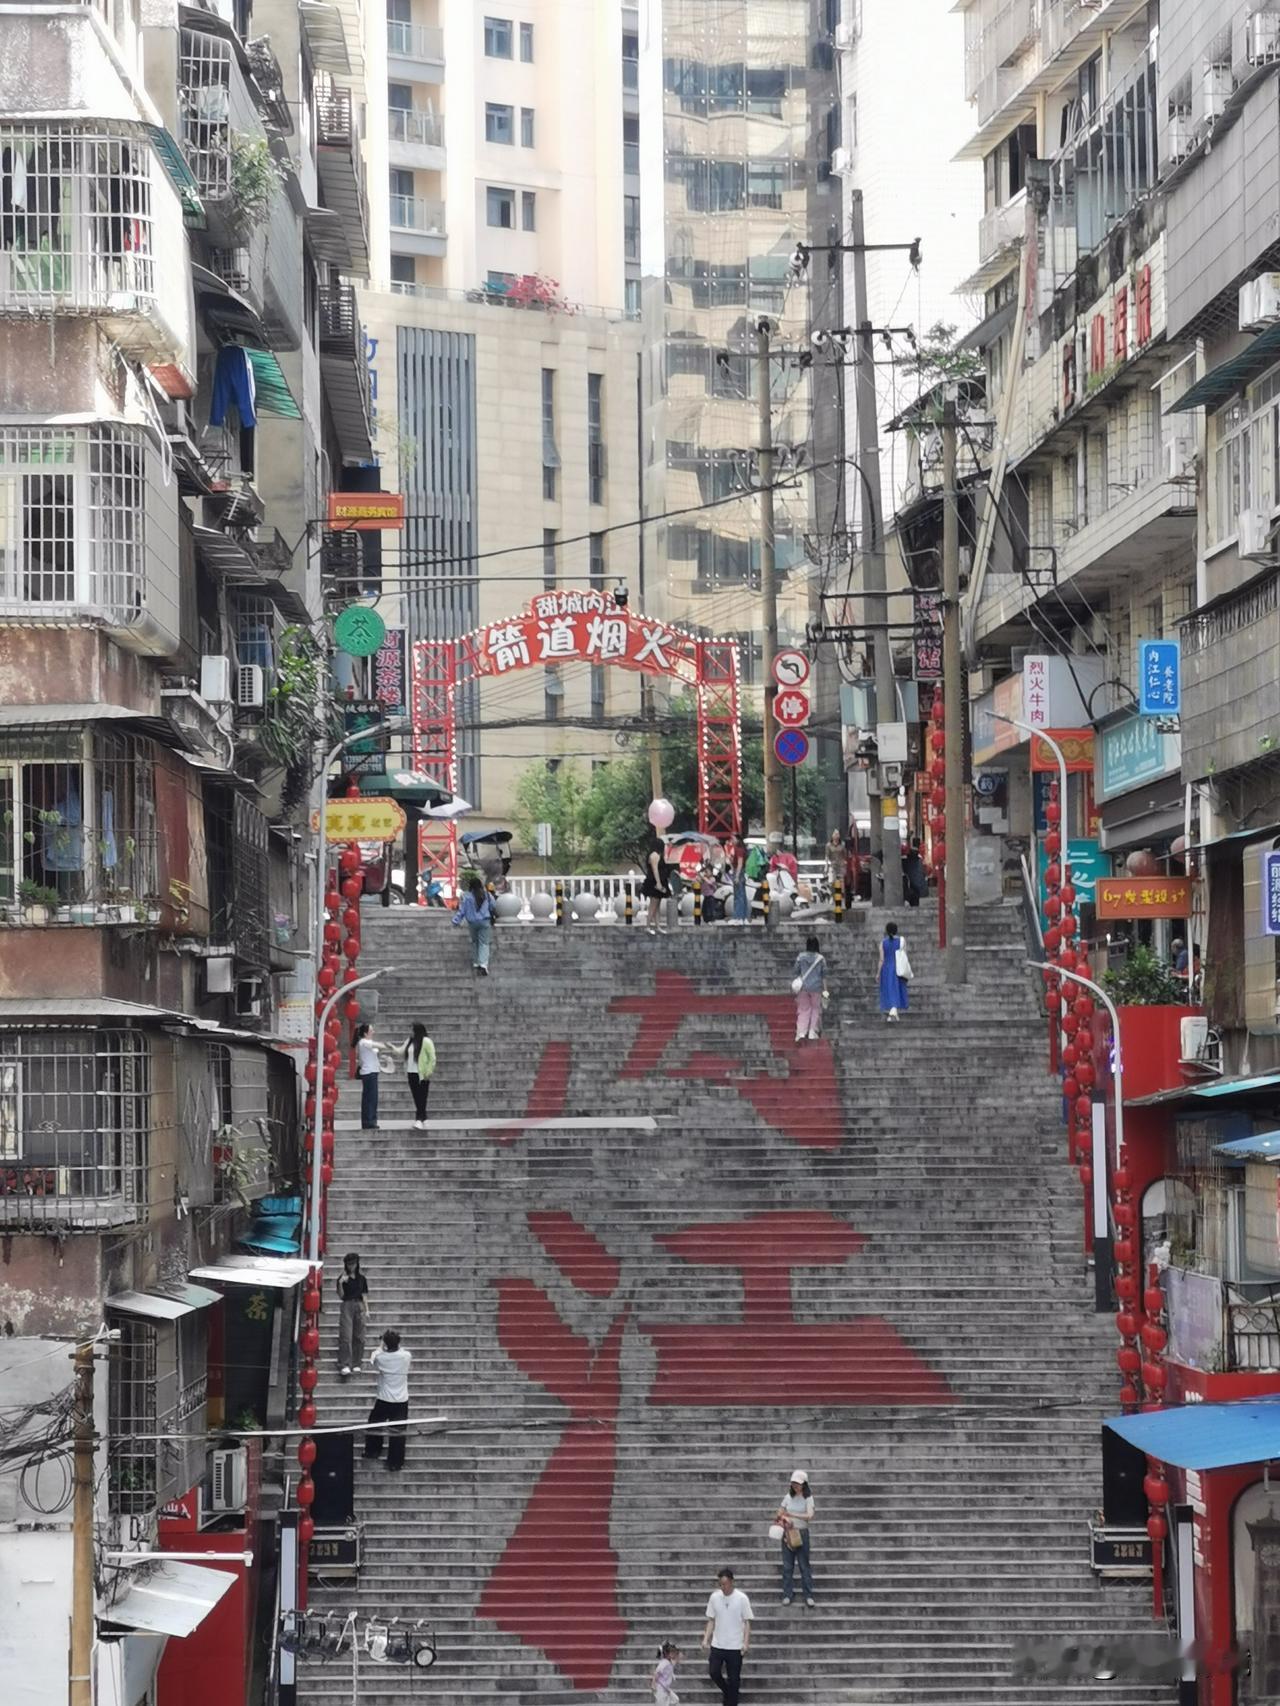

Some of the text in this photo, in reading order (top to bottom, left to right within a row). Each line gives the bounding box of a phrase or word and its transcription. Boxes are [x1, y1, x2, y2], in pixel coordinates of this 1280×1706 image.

[347, 615, 372, 644] 茶
[536, 594, 627, 618] 甜城内江
[376, 630, 402, 705] 财源茶楼
[487, 616, 673, 672] 箭道烟火
[1029, 661, 1044, 723] 烈火牛肉
[1147, 650, 1160, 699] 内江仁心
